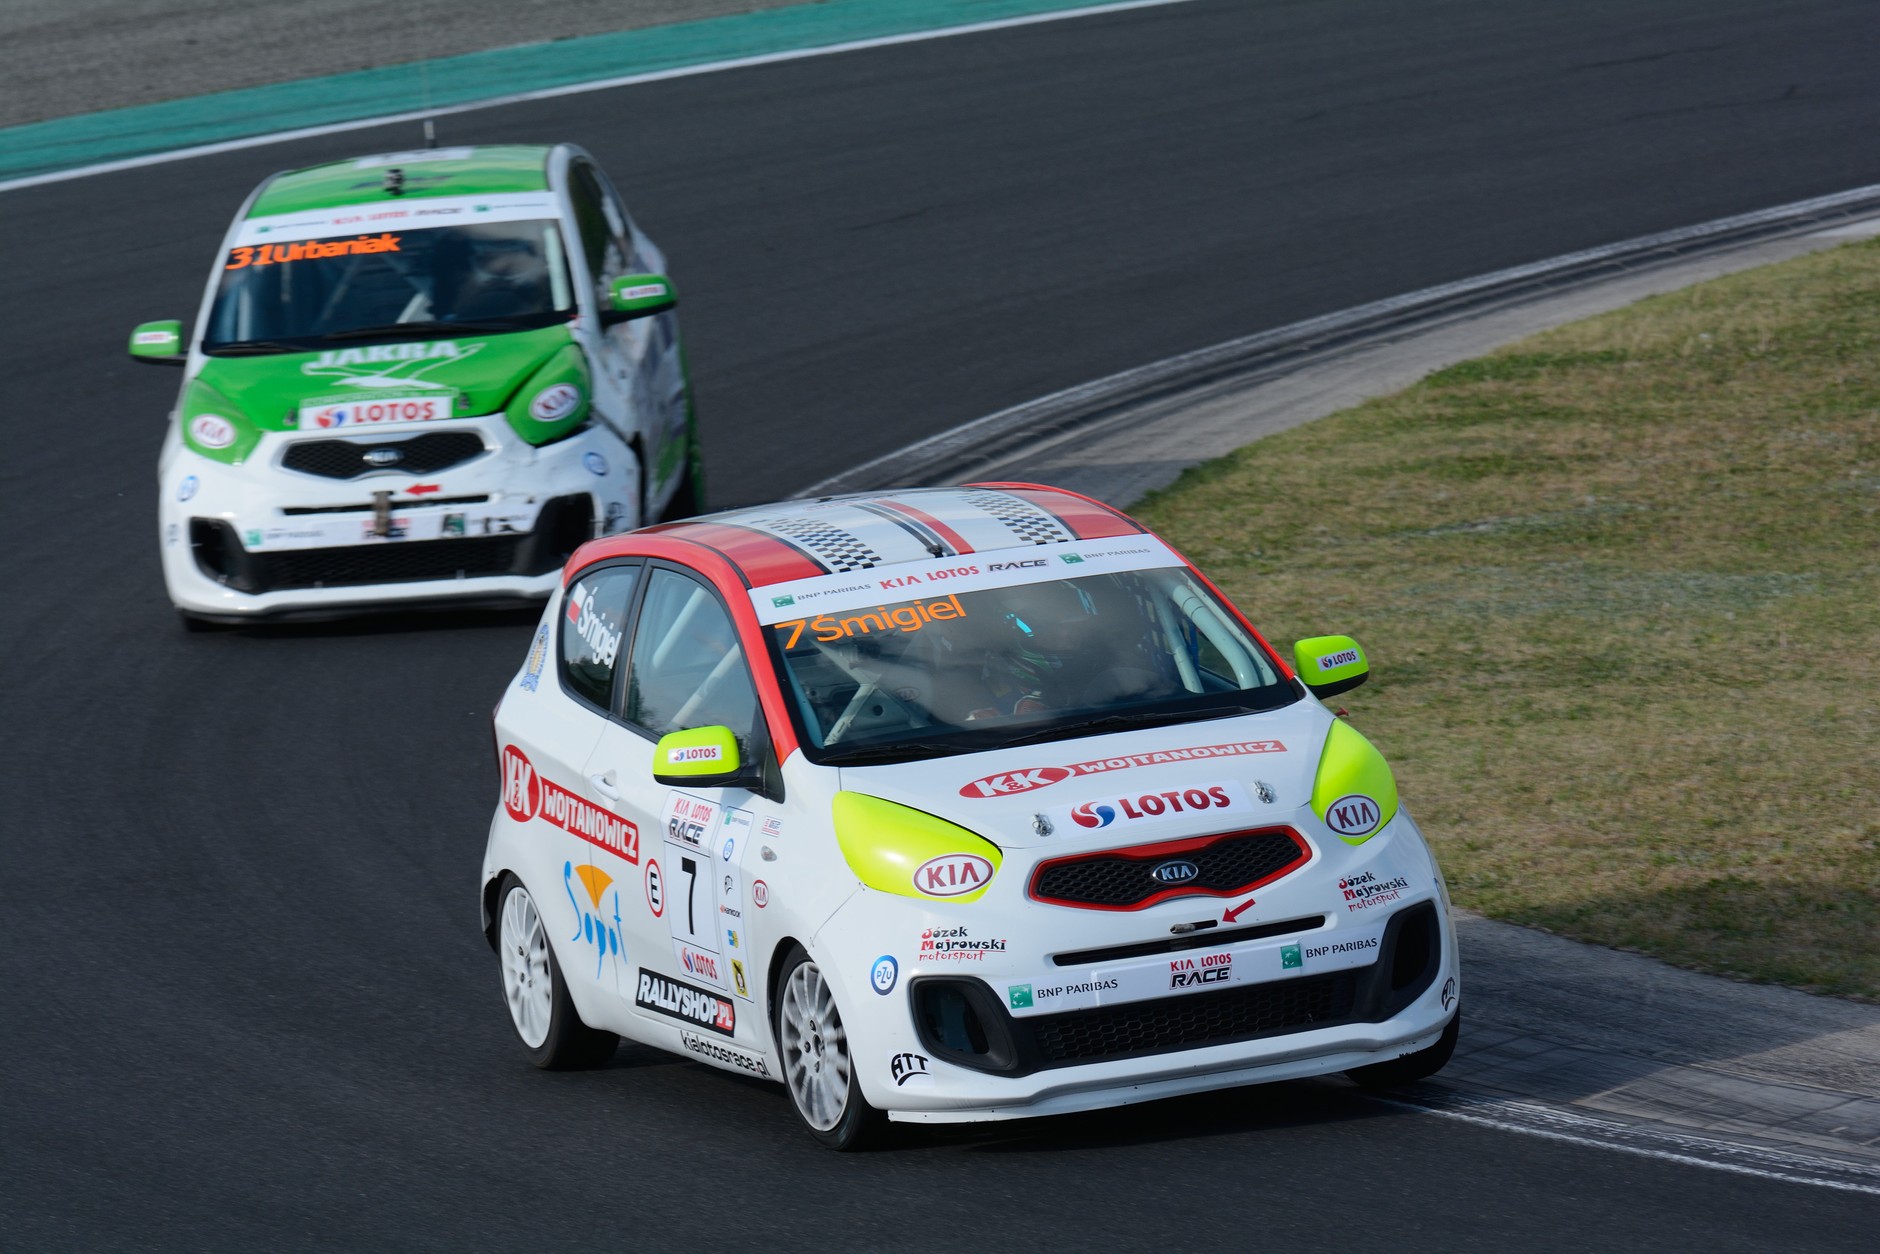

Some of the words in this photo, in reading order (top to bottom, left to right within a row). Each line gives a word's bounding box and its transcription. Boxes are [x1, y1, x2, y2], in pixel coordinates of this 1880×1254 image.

[352, 402, 435, 424] LOTOS
[797, 591, 823, 601] BNP
[824, 584, 872, 595] PARIBAS
[879, 575, 923, 590] KIA
[926, 566, 981, 582] LOTOS
[989, 559, 1047, 572] RACE
[1083, 552, 1104, 560] BNP
[1106, 548, 1152, 557] PARIBAS
[577, 586, 622, 670] Śmigiel
[774, 620, 807, 650] 7
[810, 594, 967, 643] Śmigiel
[1332, 651, 1357, 666] LOTOS
[686, 747, 717, 760] LOTOS
[973, 768, 1056, 798] K&K
[1079, 741, 1281, 774] WOJTANOWICZ
[504, 750, 533, 817] K&K
[544, 784, 637, 859] WOJTANOWICZ
[674, 798, 690, 817] KIA
[690, 803, 714, 823] LOTOS
[1118, 785, 1232, 820] LOTOS
[1334, 802, 1376, 830] KIA
[669, 818, 705, 845] RACE
[926, 862, 980, 889] KIA
[1160, 867, 1193, 881] KIA
[1338, 871, 1377, 889] Józek
[649, 871, 660, 905] E
[681, 857, 697, 936] 7
[754, 886, 767, 902] KIA
[1343, 877, 1409, 901] Majrowski
[1348, 890, 1402, 913] motorsport
[921, 926, 968, 940] Józek
[919, 949, 986, 964] motorsport
[920, 938, 1007, 953] Majrowski
[1305, 946, 1330, 959] BNP
[1331, 938, 1378, 954] PARIBAS
[692, 952, 718, 981] LOTOS
[876, 966, 893, 984] PZU
[1170, 958, 1195, 973] KIA
[1200, 953, 1232, 968] LOTOS
[1037, 986, 1063, 999] BNP
[1066, 978, 1119, 996] PARIBAS
[1171, 967, 1231, 989] RACE
[637, 973, 733, 1028] RALLYSHOP.PL
[680, 1030, 772, 1079] kialotosrace.pl
[891, 1053, 929, 1081] ATT
